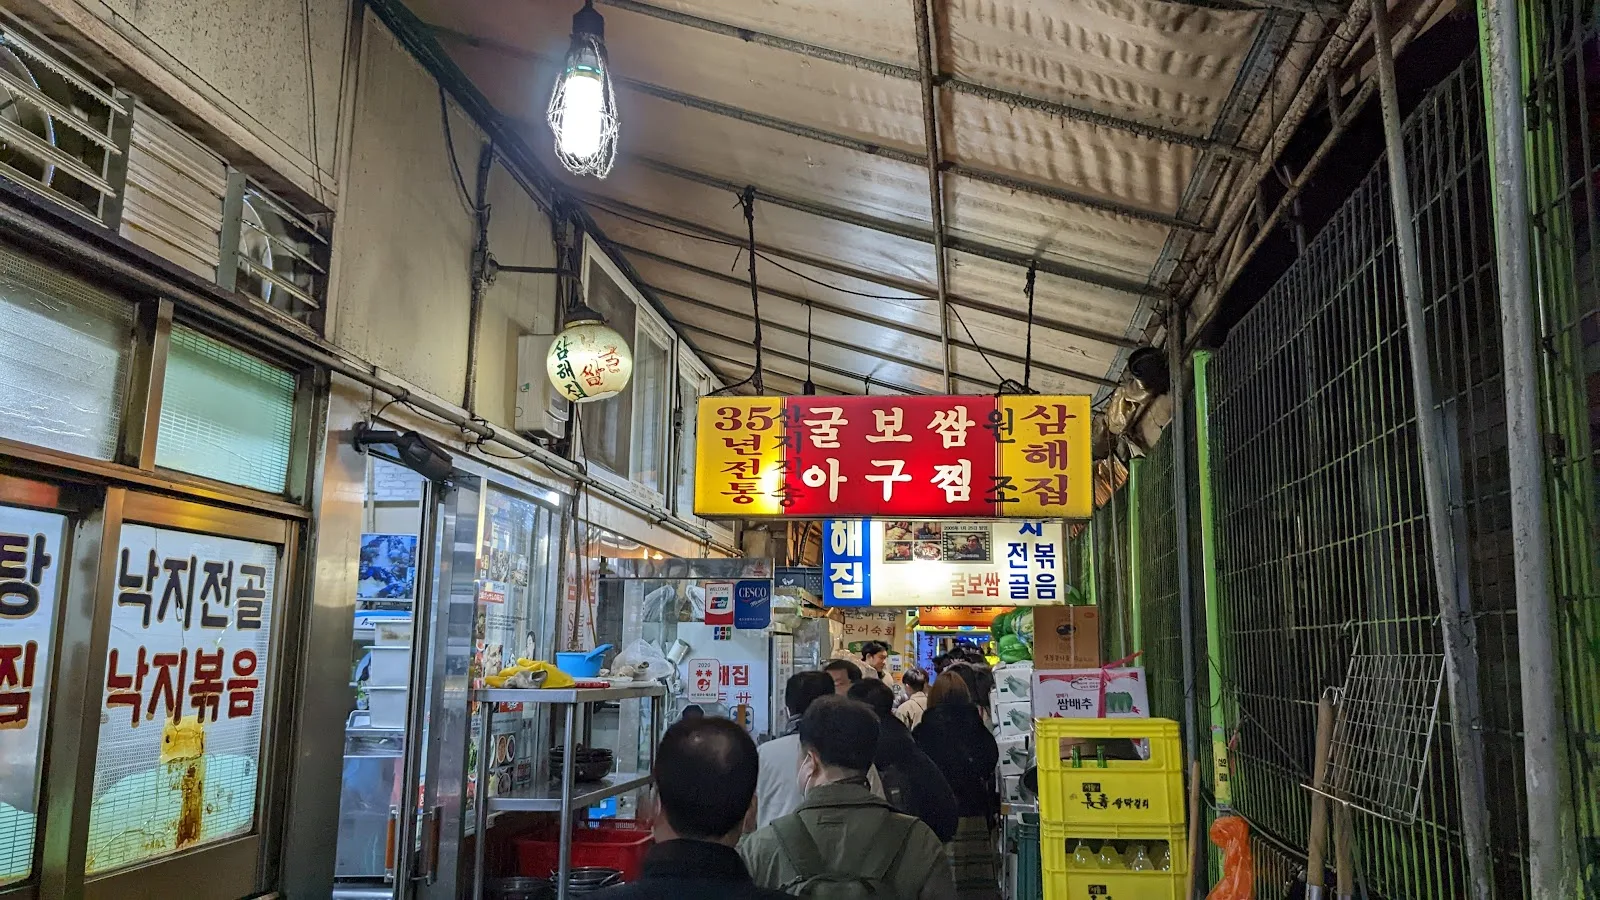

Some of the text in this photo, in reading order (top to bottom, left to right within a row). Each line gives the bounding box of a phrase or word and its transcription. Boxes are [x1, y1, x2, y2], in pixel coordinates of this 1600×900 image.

[803, 405, 976, 449] 굴보쌈
[1020, 403, 1077, 507] 삼해집
[802, 457, 973, 503] 아구찜
[117, 547, 267, 630] 낙지전골
[738, 587, 767, 598] CESCO
[950, 572, 1000, 597] 굴보쌈
[843, 623, 896, 637] 문어숙회
[105, 645, 259, 728] 낙지볶음
[1057, 698, 1093, 711] 쌈배추
